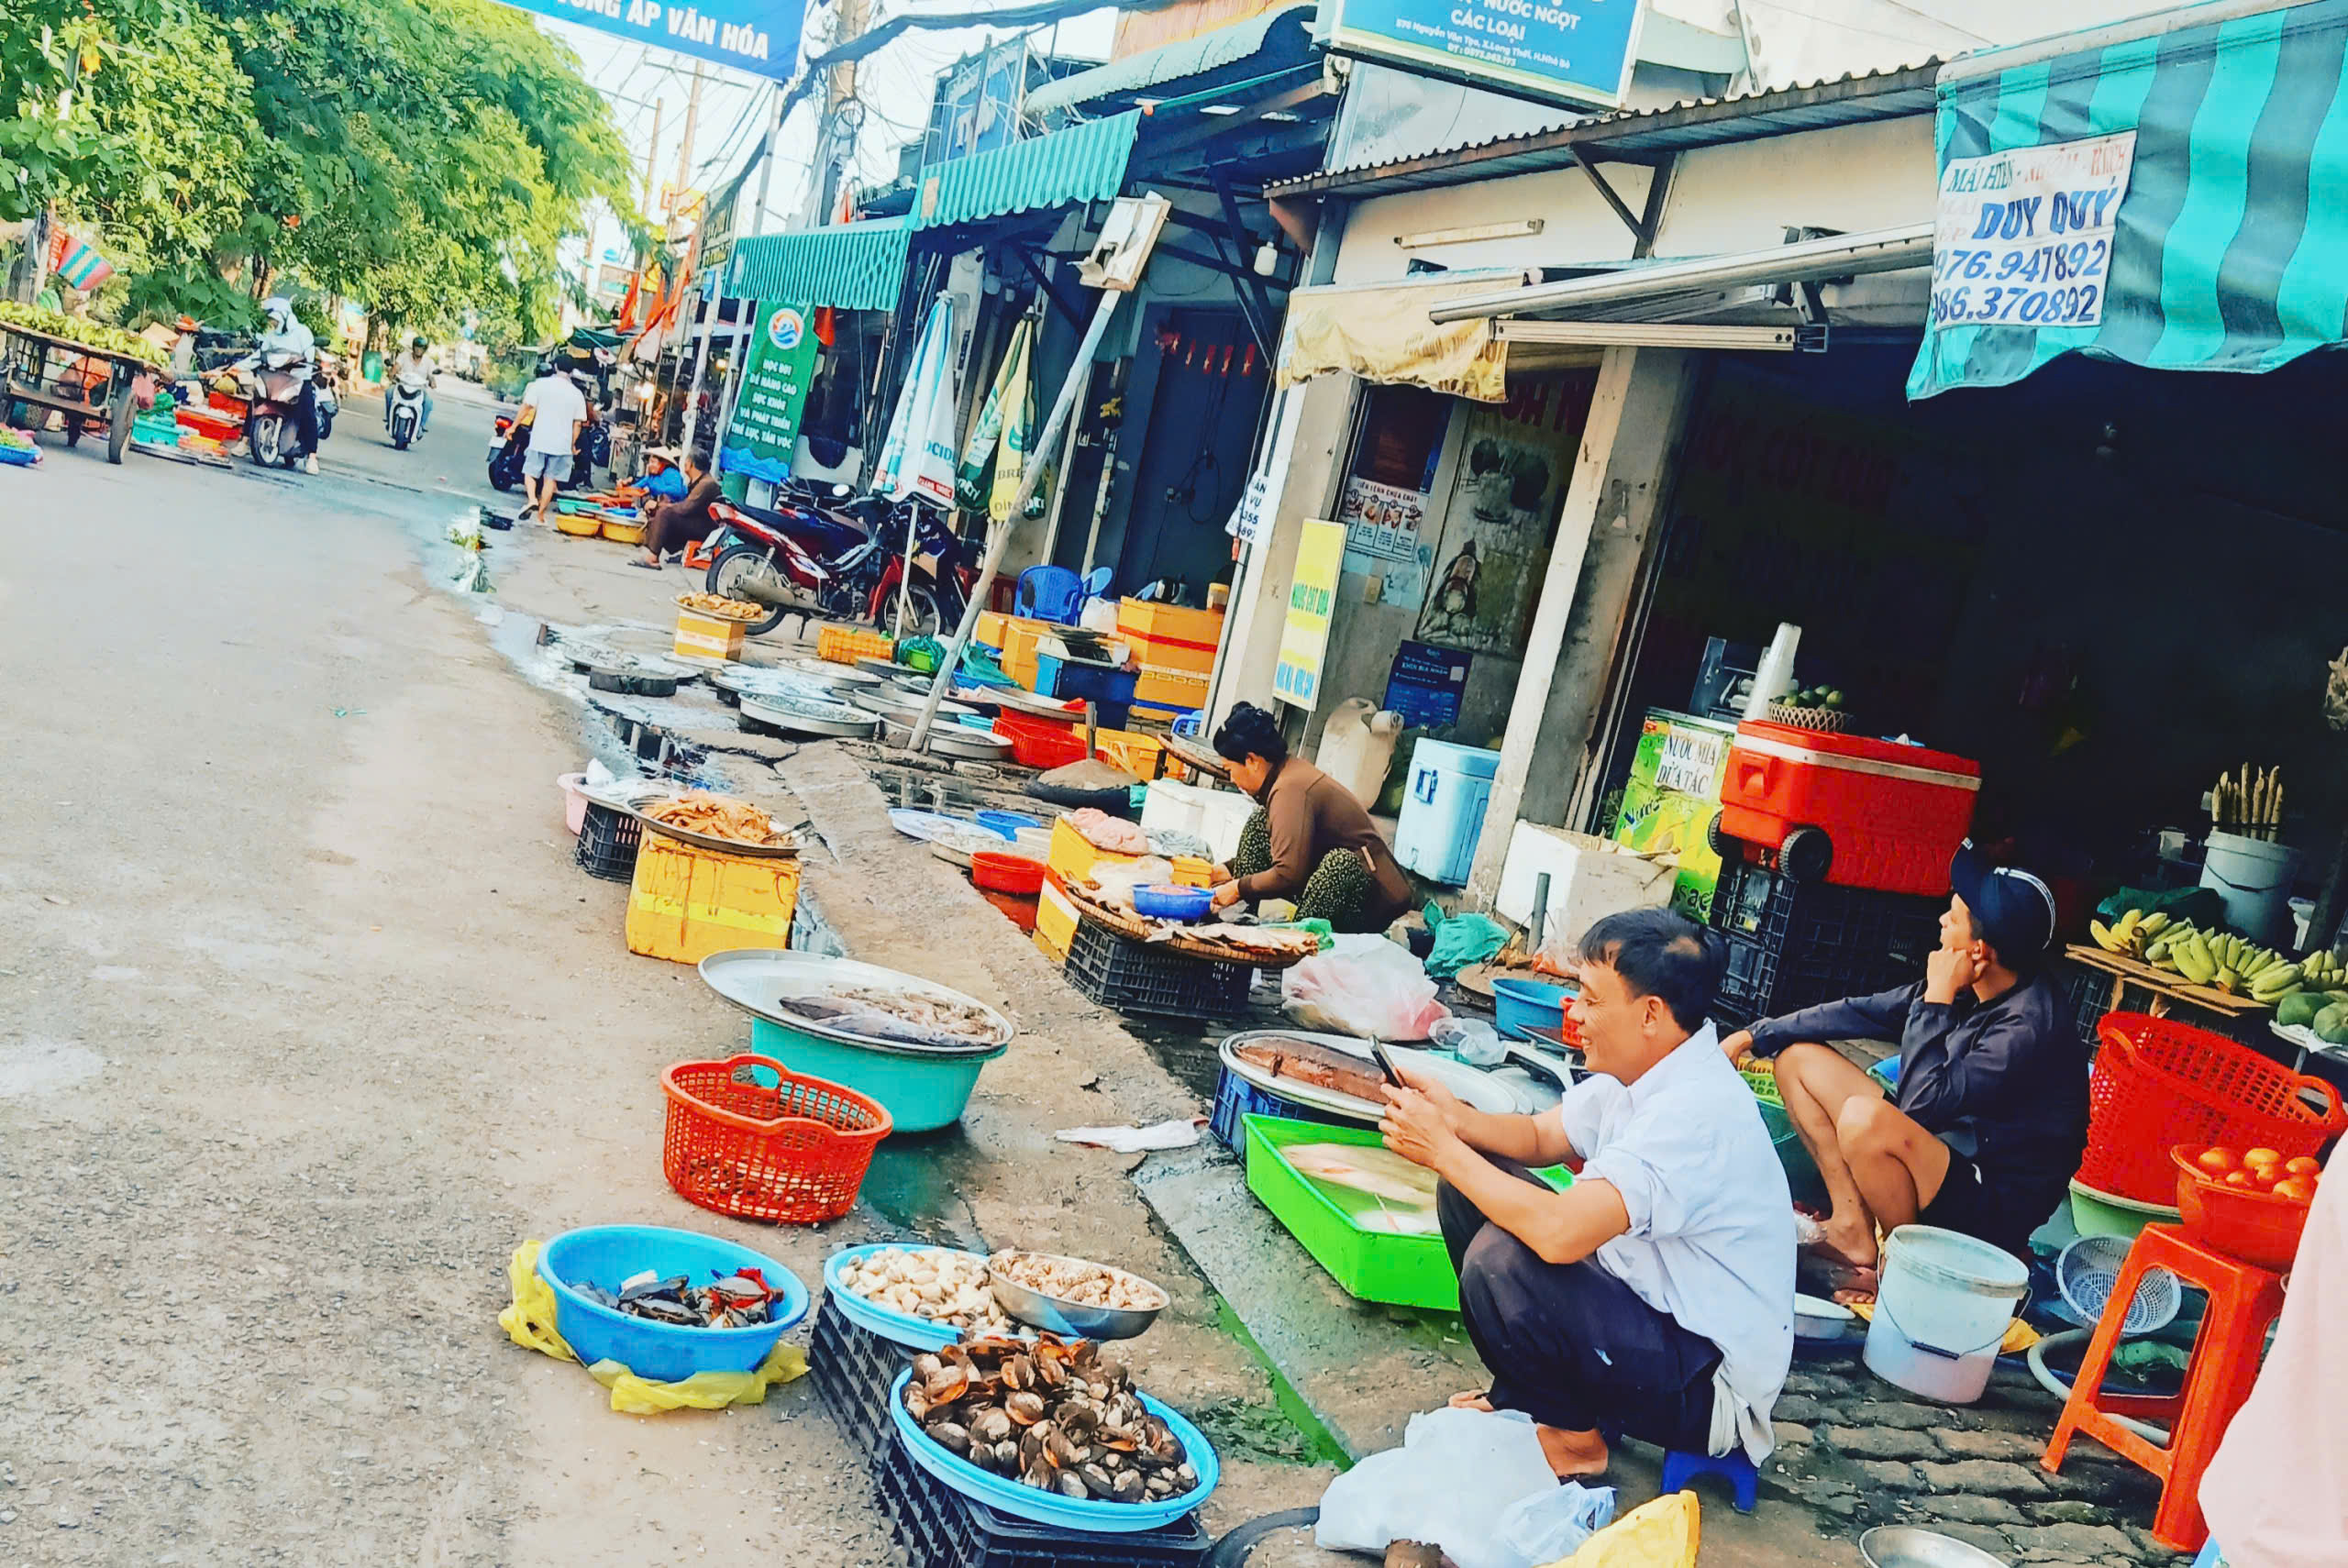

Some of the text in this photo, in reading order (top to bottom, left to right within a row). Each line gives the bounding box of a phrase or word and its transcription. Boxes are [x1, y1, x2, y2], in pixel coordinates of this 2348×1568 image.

[668, 7, 716, 45] VĂN
[720, 23, 768, 61] HÓA
[1451, 8, 1527, 44] CÁC LOẠI
[1534, 6, 1581, 32] NGỌT
[1972, 195, 2043, 240] DUY
[2050, 176, 2119, 236] QUÝ
